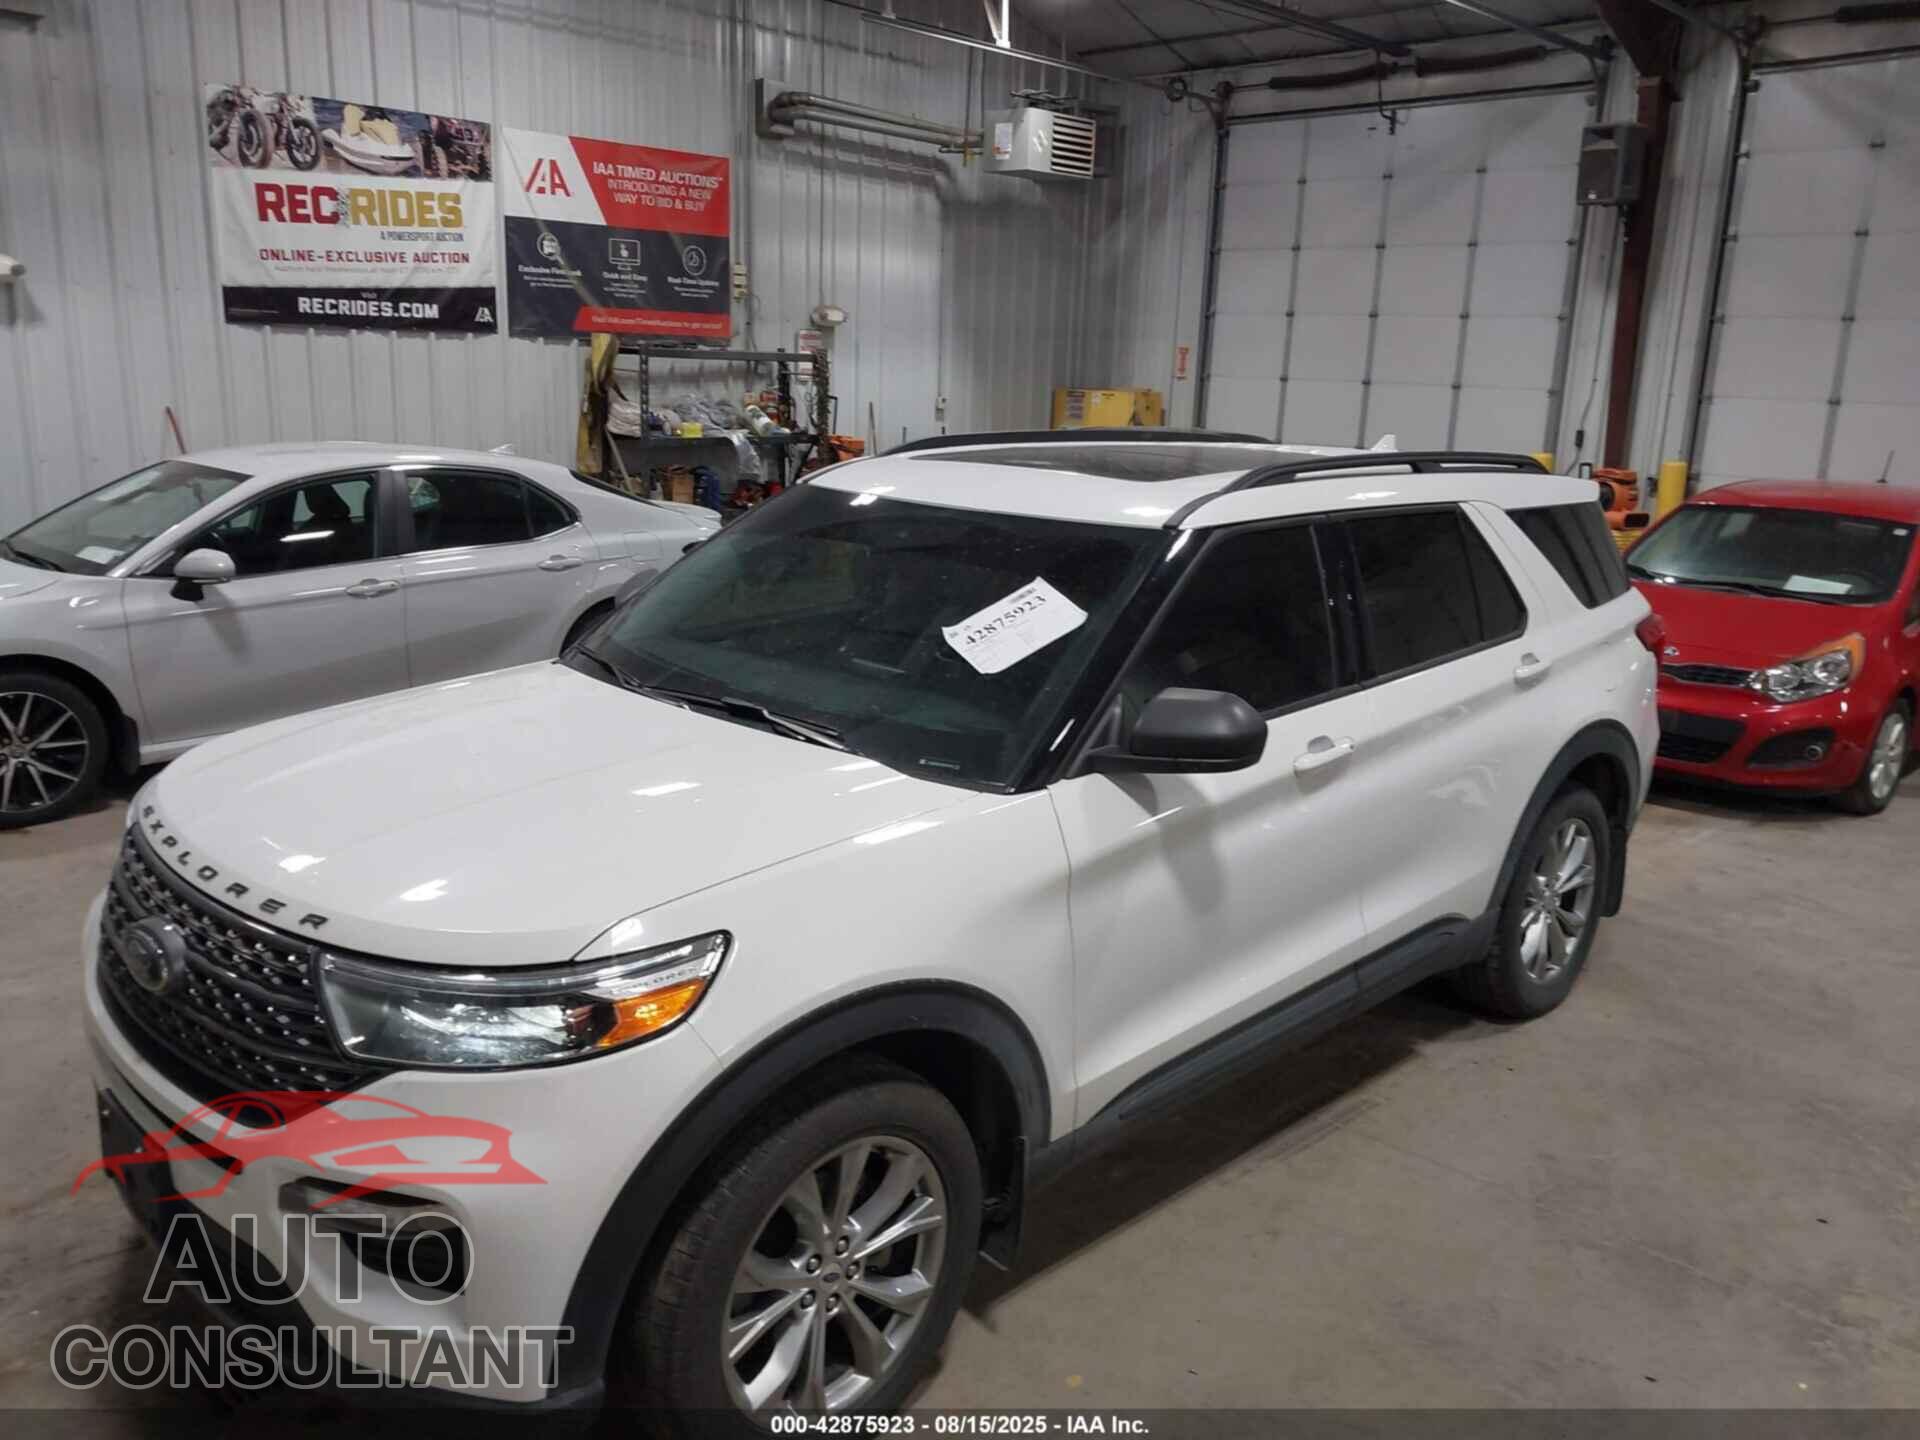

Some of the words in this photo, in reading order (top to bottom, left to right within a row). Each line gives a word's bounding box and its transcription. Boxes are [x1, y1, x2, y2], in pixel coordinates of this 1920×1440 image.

[616, 164, 656, 182] TIMED
[608, 180, 678, 198] INTRODUCING
[688, 189, 712, 200] NEW
[255, 183, 341, 225] REC
[348, 188, 464, 229] RIDES
[614, 193, 639, 205] WAY
[641, 196, 655, 207] TO
[684, 200, 705, 212] BUY
[259, 249, 407, 264] ONLINE-EXCLUSIVE
[412, 252, 470, 264] AUCTION
[298, 296, 439, 318] RECRIDES.COM
[966, 595, 1047, 645] 42875923
[144, 805, 329, 929] EXPLORER
